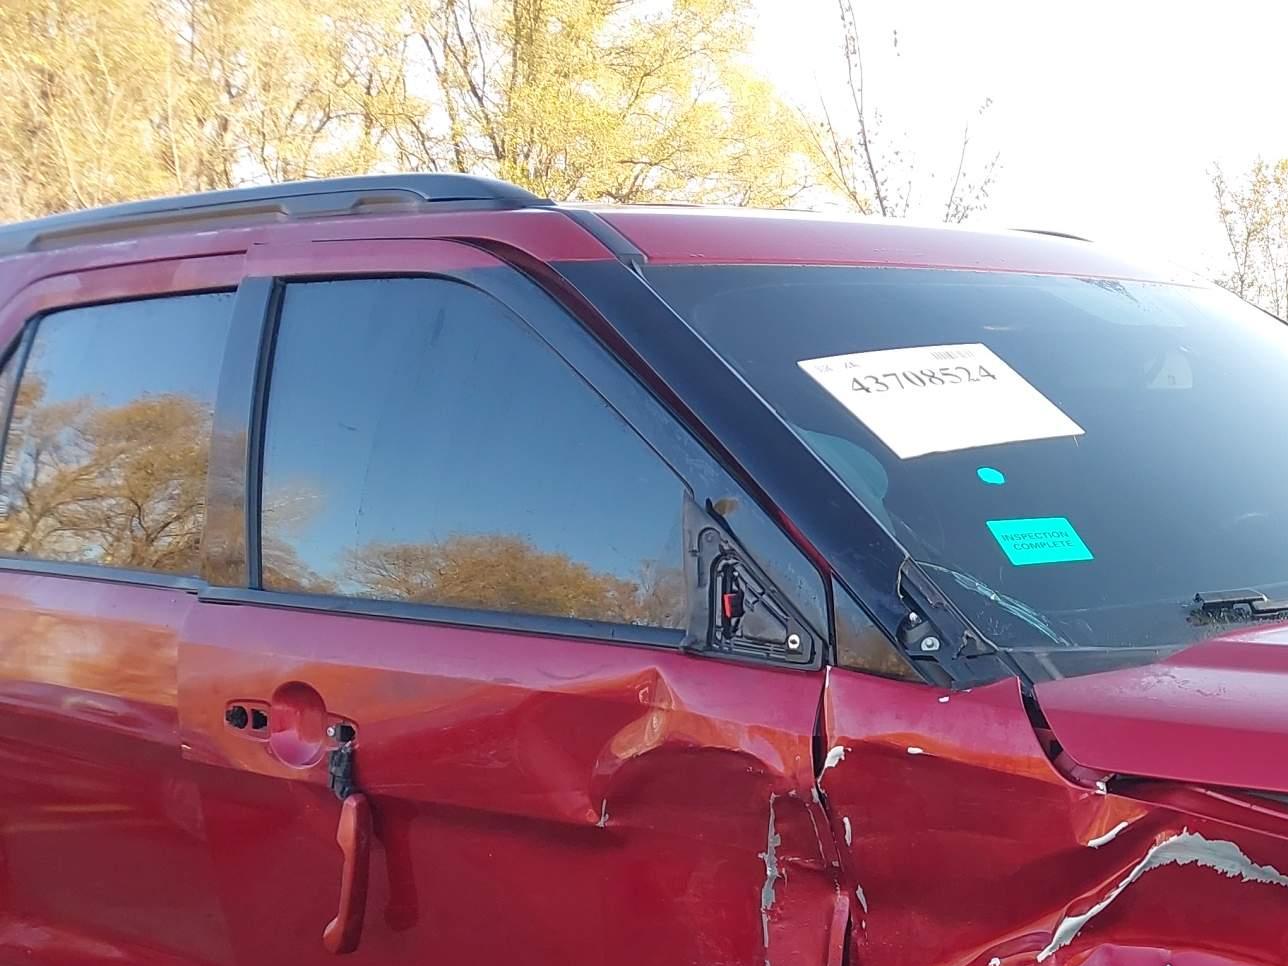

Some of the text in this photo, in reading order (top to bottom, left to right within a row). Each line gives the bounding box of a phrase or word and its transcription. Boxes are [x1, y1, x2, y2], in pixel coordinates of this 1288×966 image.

[852, 365, 997, 393] 43708524
[1001, 531, 1069, 541] INSPECTION
[1013, 541, 1073, 550] COMPLETE
